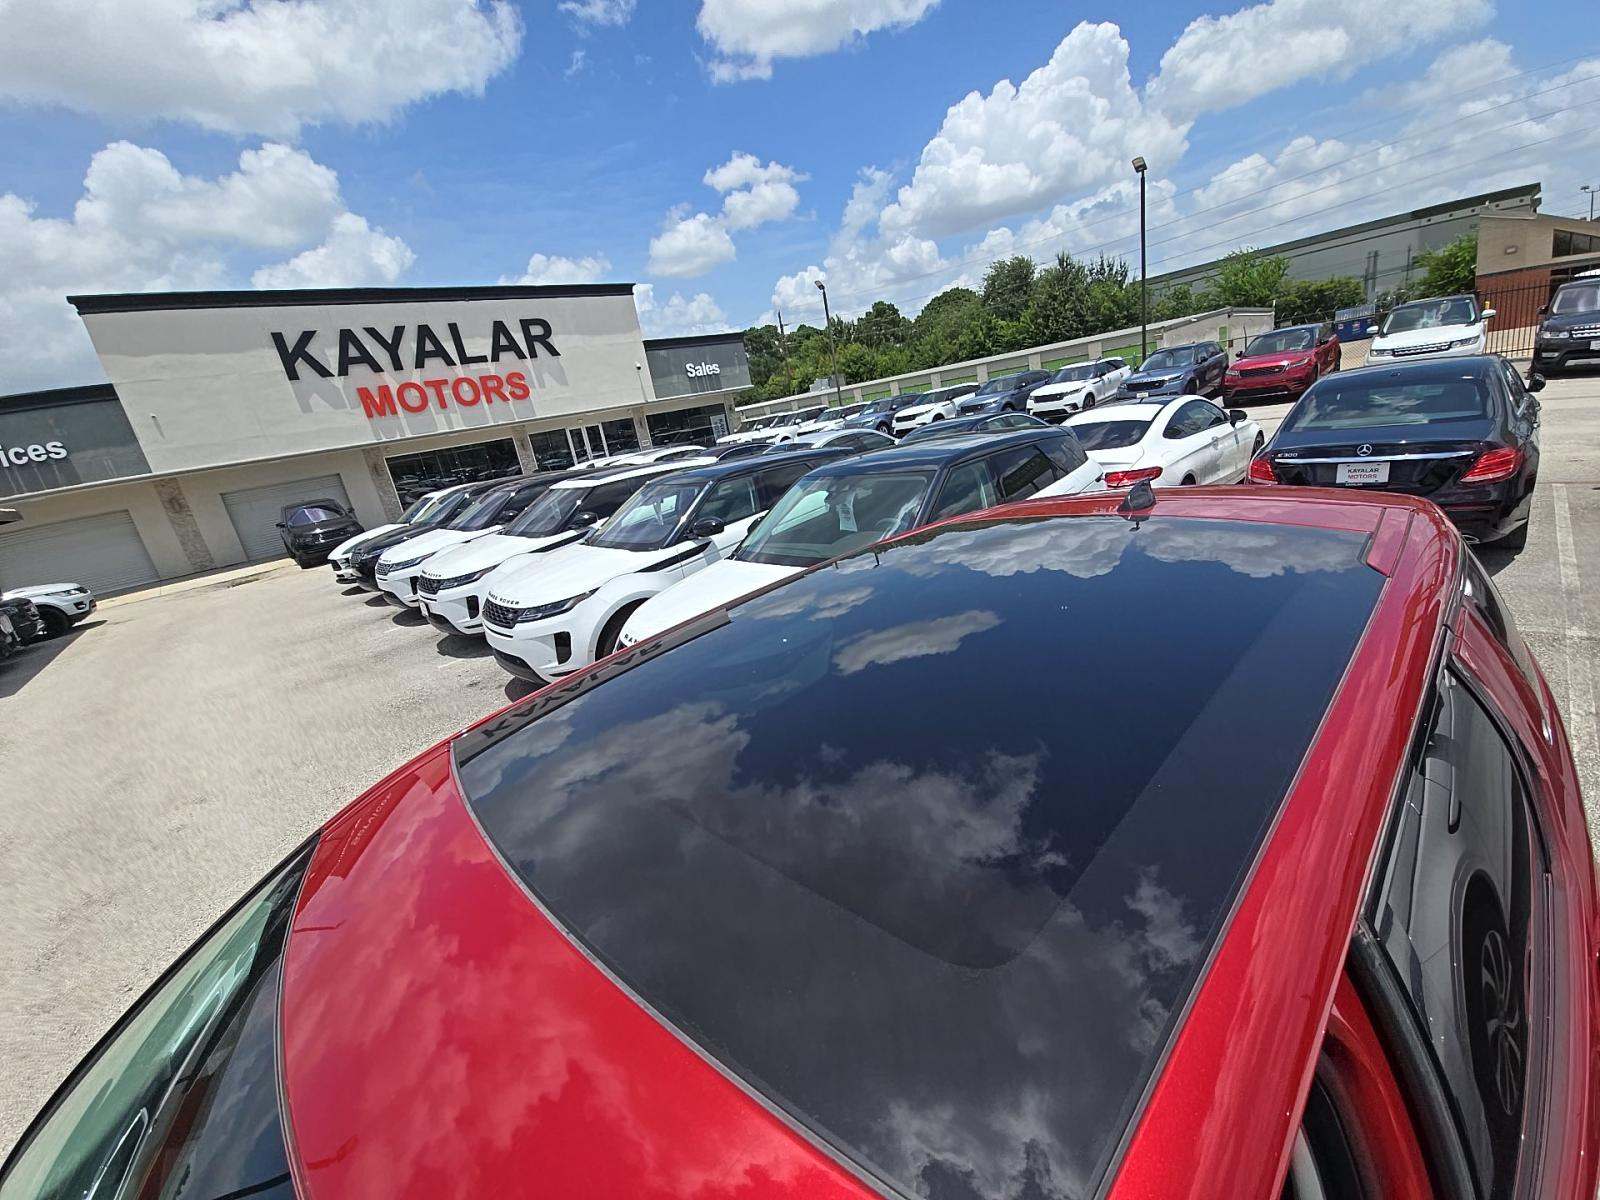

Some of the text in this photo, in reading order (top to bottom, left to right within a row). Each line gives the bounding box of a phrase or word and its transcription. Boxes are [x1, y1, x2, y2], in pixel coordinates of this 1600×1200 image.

[270, 317, 562, 382] KAYALAR
[685, 361, 721, 378] Sales
[356, 371, 532, 419] MOTORS
